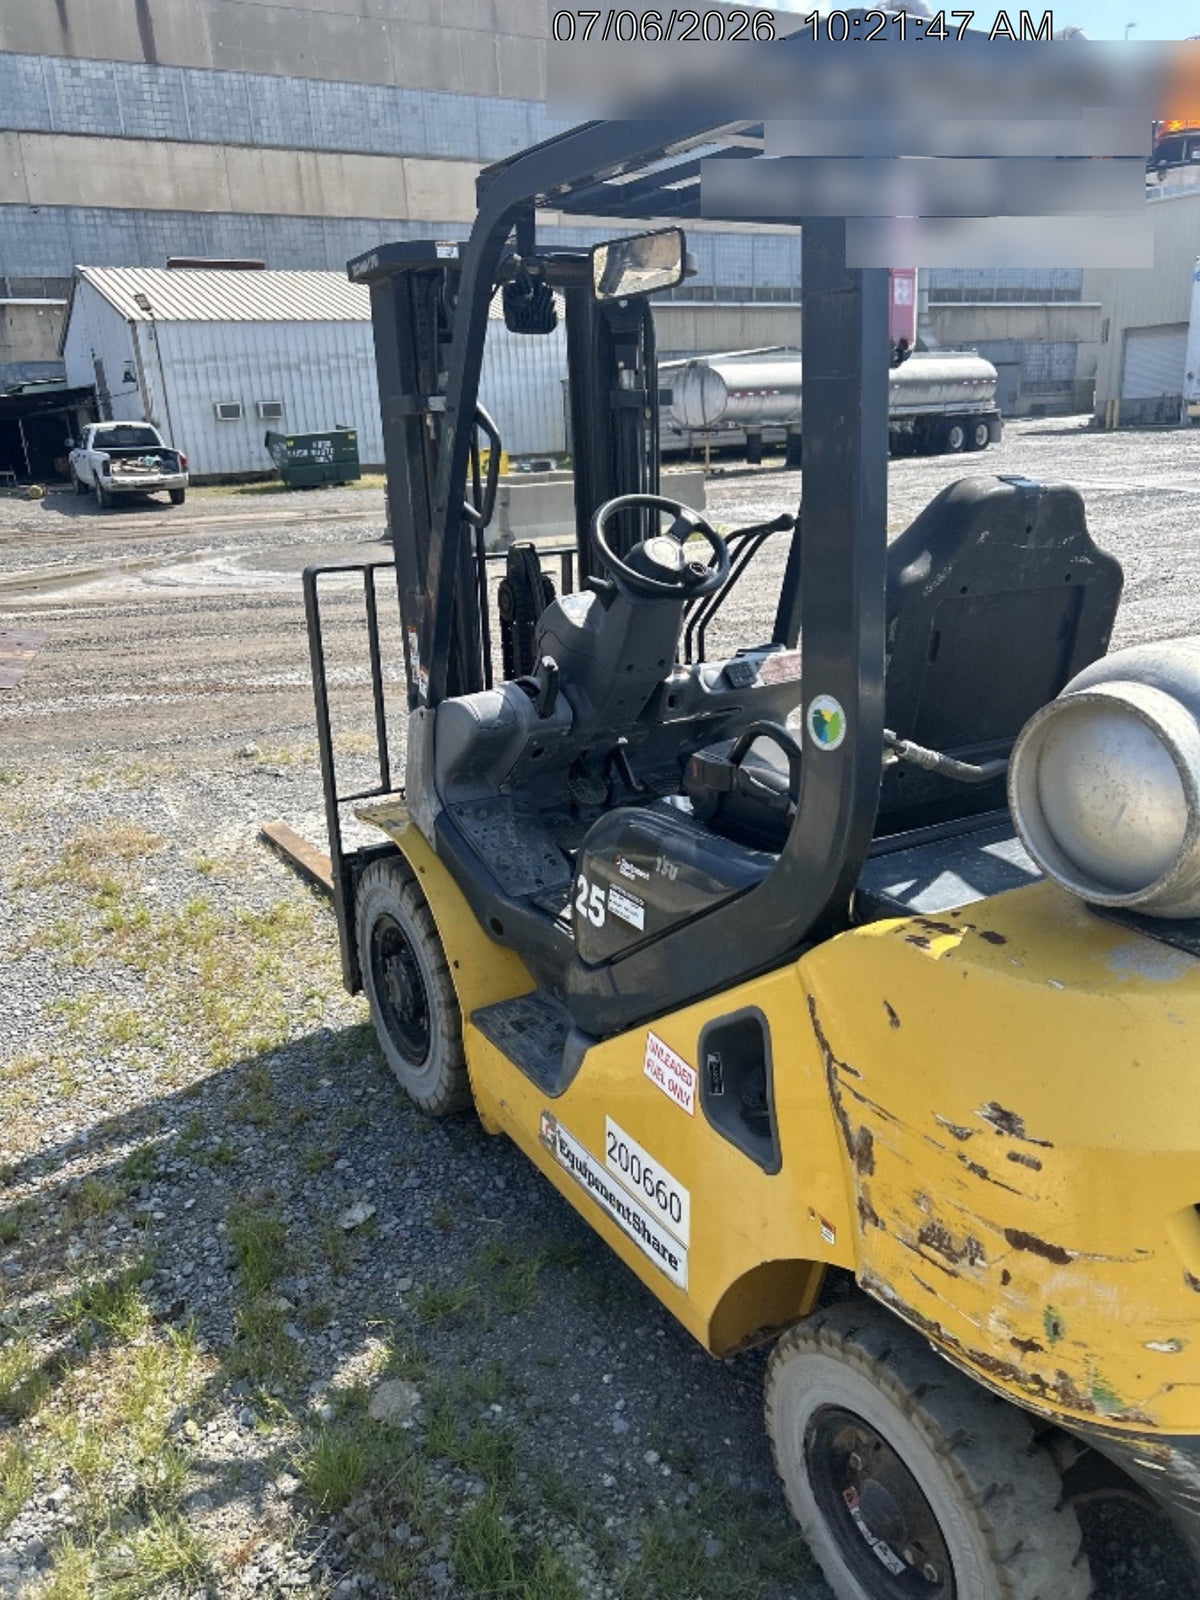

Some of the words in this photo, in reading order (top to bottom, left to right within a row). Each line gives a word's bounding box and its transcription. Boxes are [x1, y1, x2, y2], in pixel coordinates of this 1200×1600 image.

[575, 873, 605, 928] 25
[646, 1057, 666, 1086] FUEL
[668, 1078, 691, 1107] ONLY
[648, 1038, 693, 1088] UNLEADED
[607, 1131, 682, 1224] 200660
[559, 1140, 679, 1272] EquipmentShare
